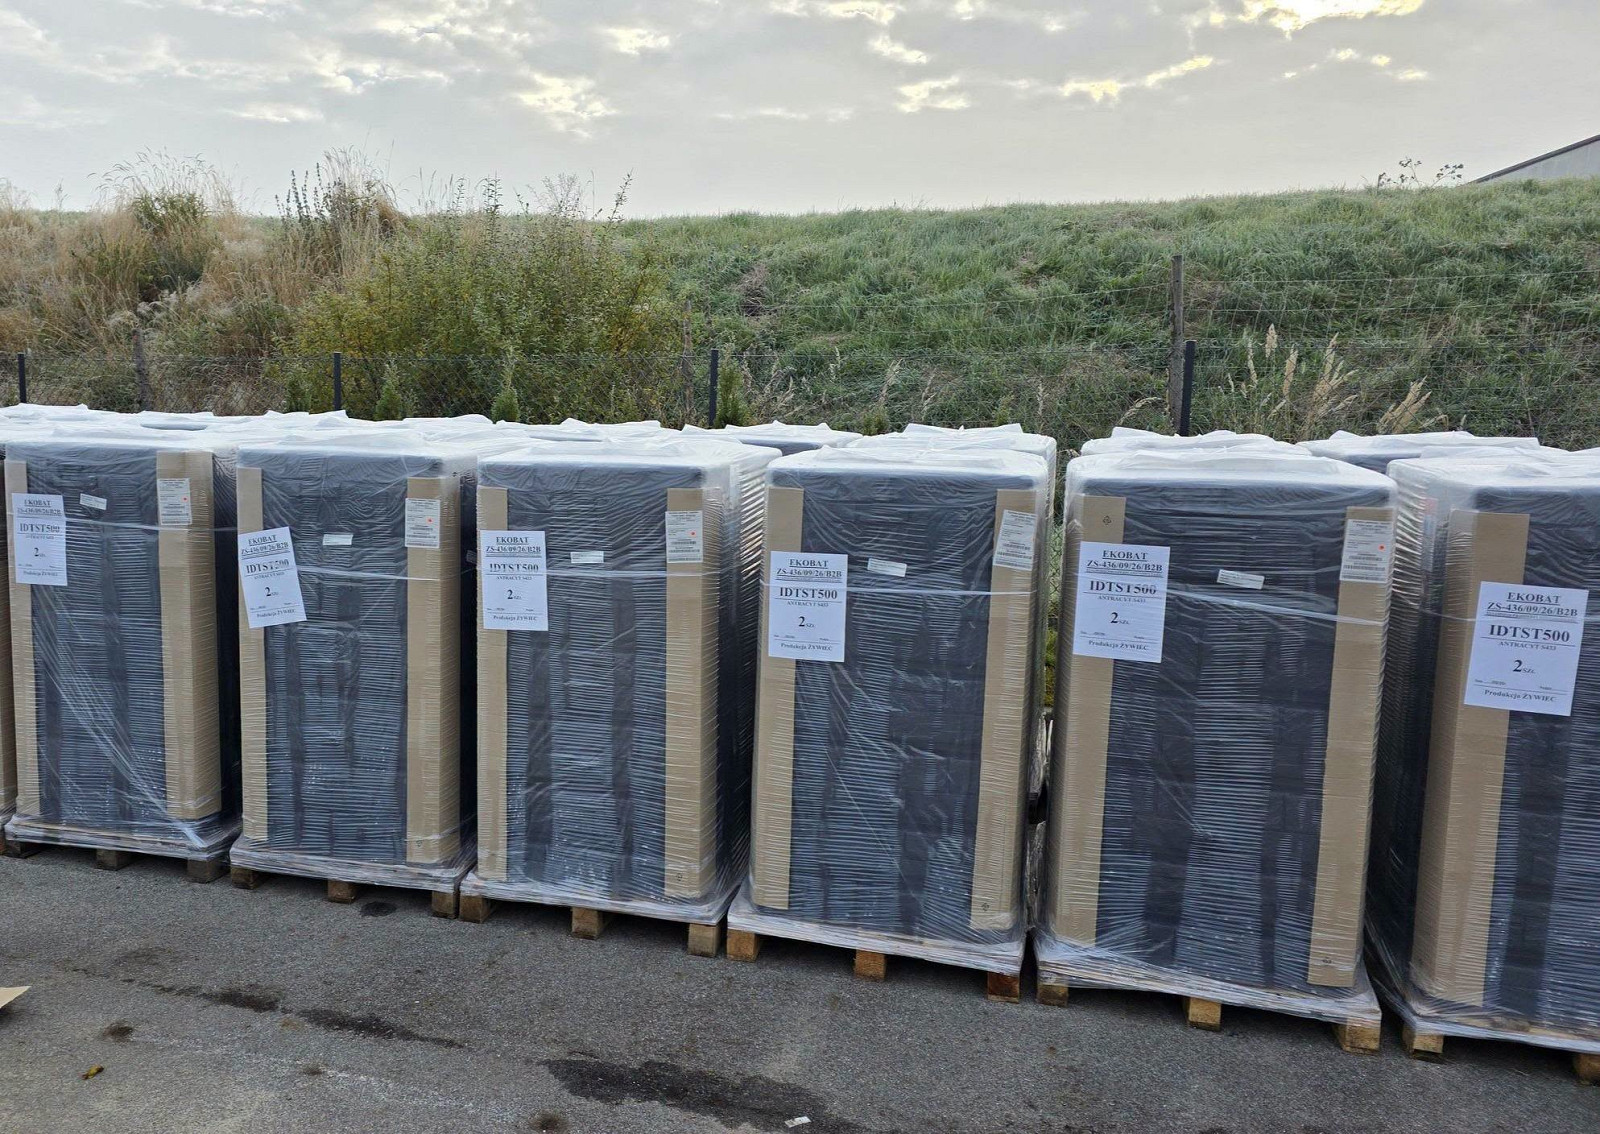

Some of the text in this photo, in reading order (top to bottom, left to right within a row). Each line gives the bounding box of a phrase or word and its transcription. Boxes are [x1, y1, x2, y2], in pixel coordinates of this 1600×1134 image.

[248, 535, 277, 545] EKOBAT
[34, 548, 39, 556] 2
[1103, 550, 1147, 560] EKOBAT
[490, 563, 539, 572] IDTST500
[789, 559, 828, 567] EKOBAT
[1087, 560, 1162, 571] ZS-436/09/26/B2B
[777, 568, 842, 577] ZS-436/09/26/B2B
[265, 587, 272, 596] 2
[1090, 581, 1157, 594] IDTST500
[507, 590, 513, 599] 2
[780, 587, 837, 599] IDTST500
[1507, 592, 1561, 603] EKOBAT
[1488, 602, 1578, 616] ZS-436/09/26/B2B
[799, 616, 805, 626] 2
[1110, 612, 1118, 624] 2
[1489, 625, 1570, 642] IDTST500
[1088, 640, 1119, 648] Produkcja
[1499, 641, 1539, 650] ANTRACYT
[1513, 660, 1522, 672] 2
[1484, 690, 1520, 699] Produkcja
